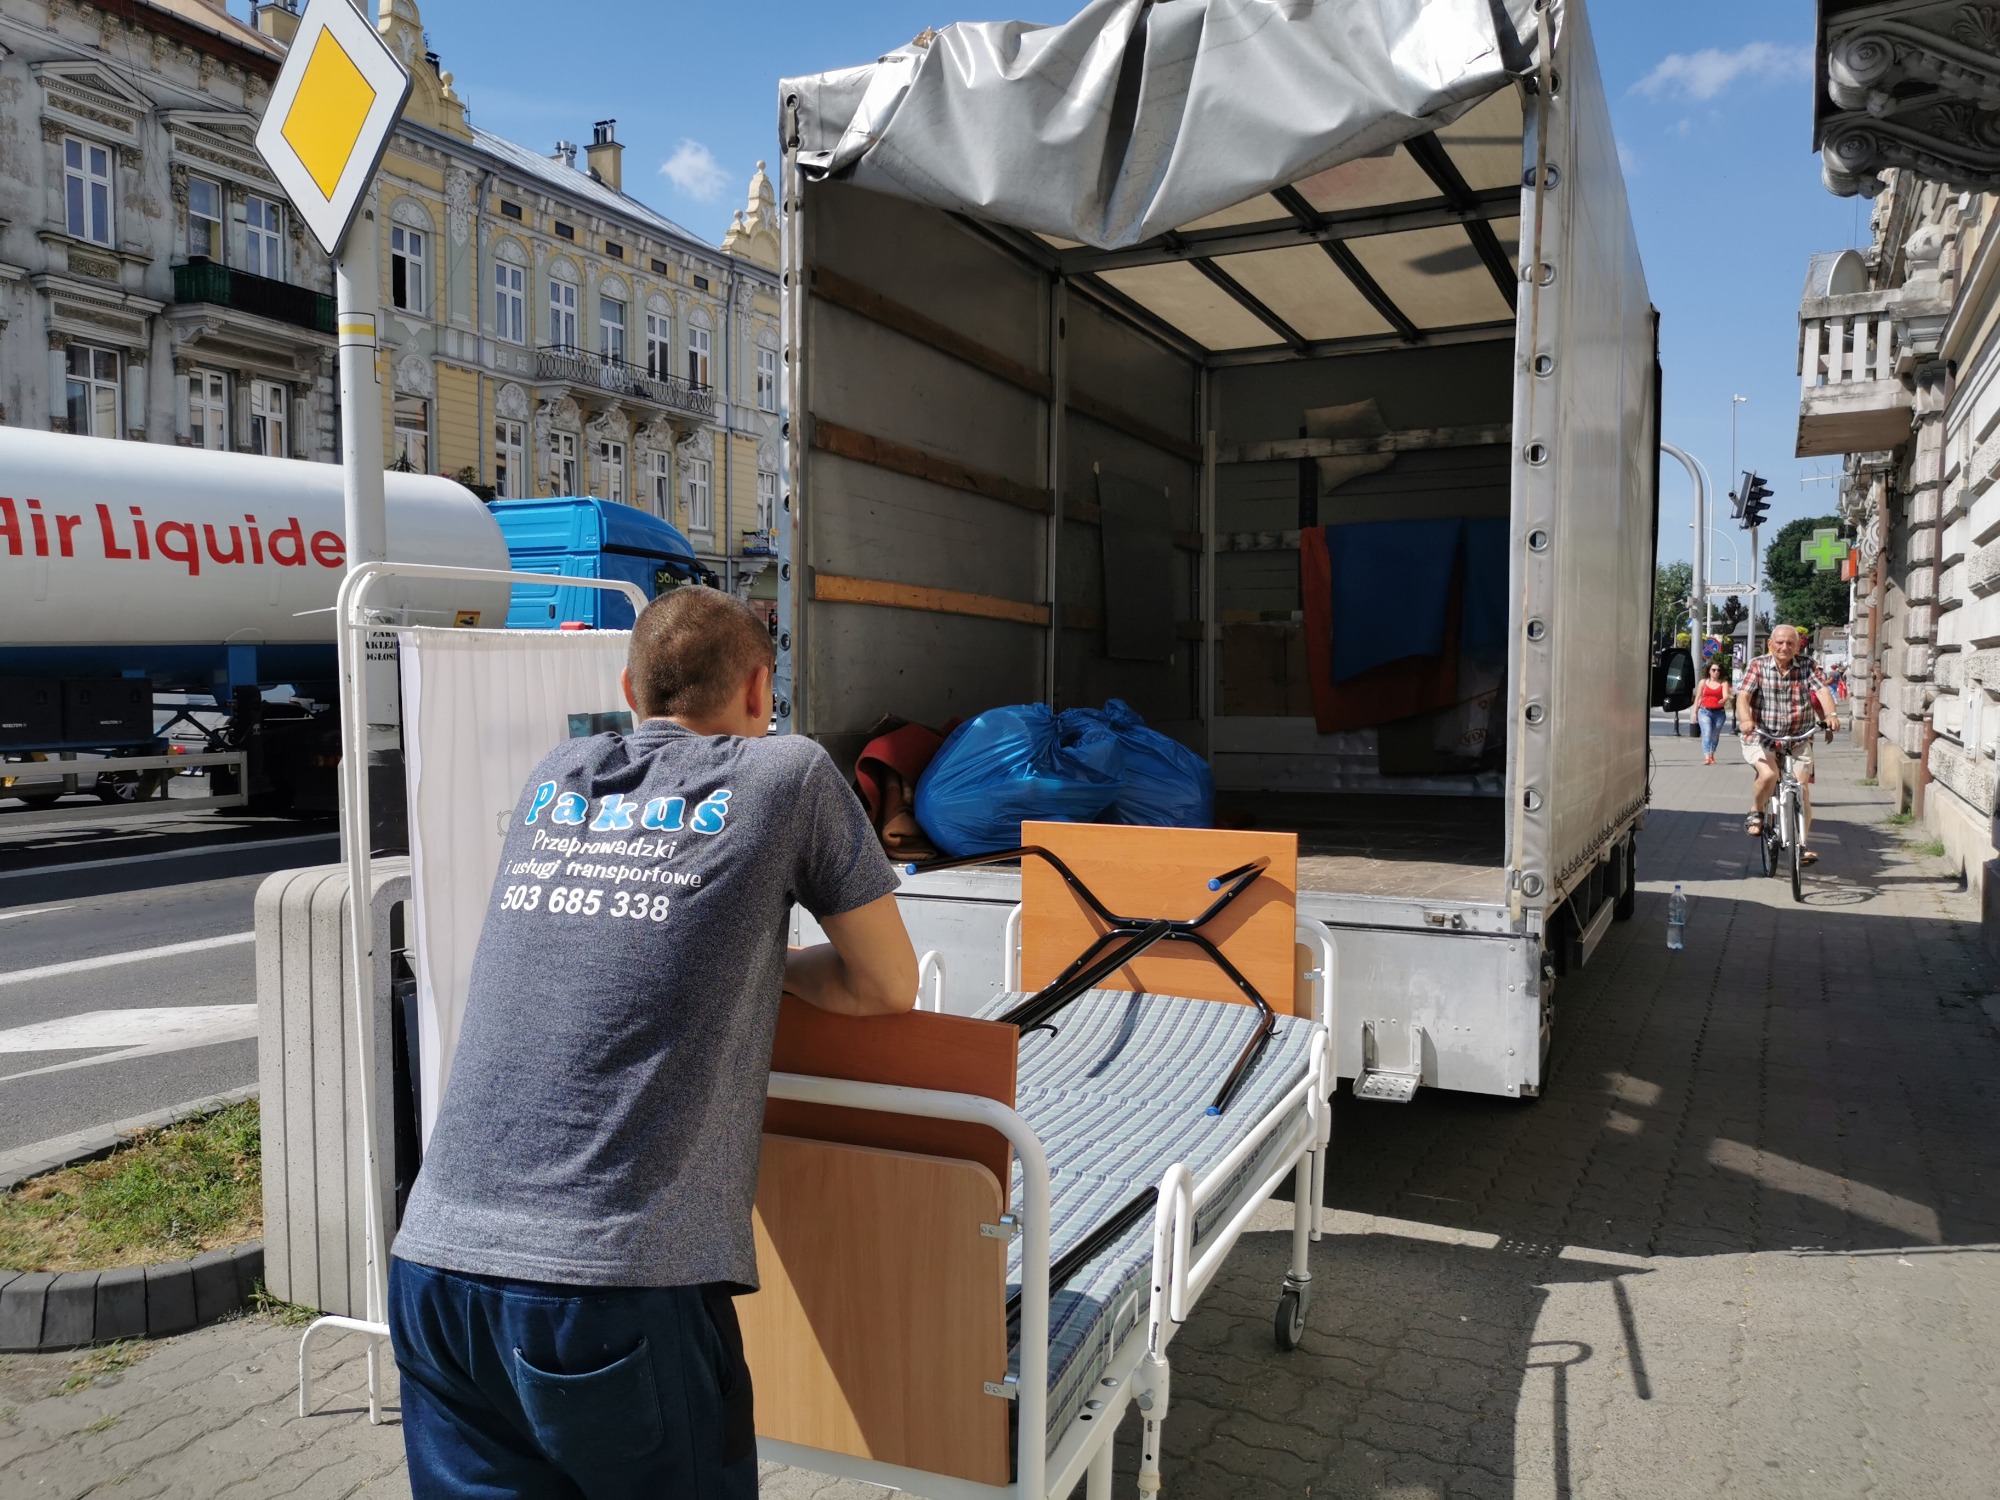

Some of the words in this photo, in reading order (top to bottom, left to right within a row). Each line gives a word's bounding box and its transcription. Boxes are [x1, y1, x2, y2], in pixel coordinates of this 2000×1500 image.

[0, 497, 82, 557] Air
[95, 503, 346, 576] Liquide
[524, 780, 733, 835] Pakuś
[532, 829, 678, 860] Przeprowadzki
[504, 860, 512, 876] i
[512, 859, 561, 881] usługi
[566, 860, 702, 888] transportowe
[501, 885, 542, 910] 503
[548, 886, 603, 915] 685
[610, 891, 670, 922] 338
